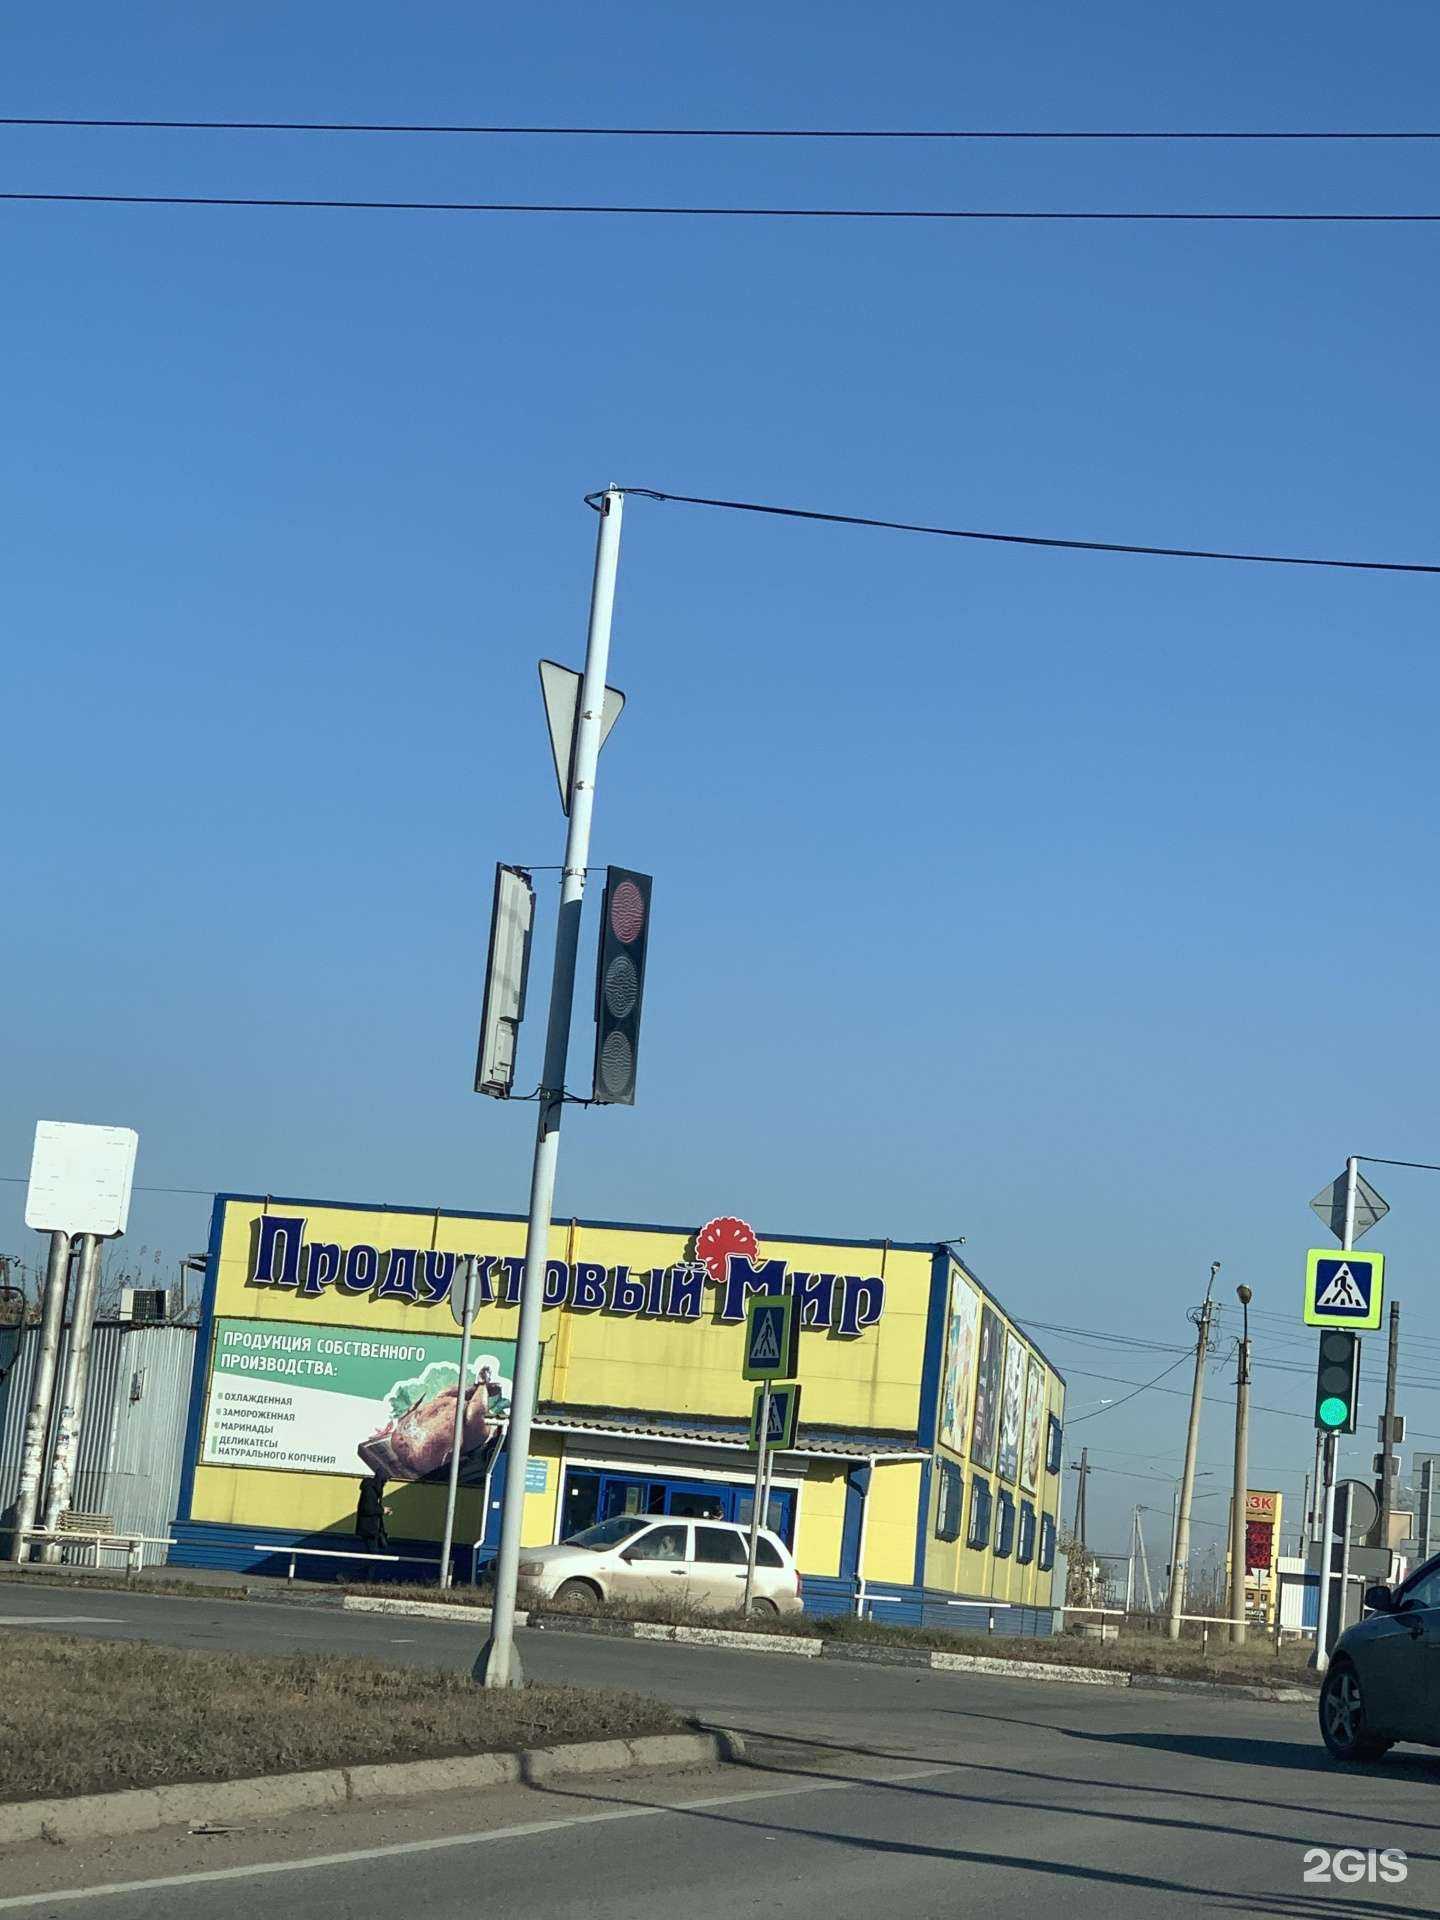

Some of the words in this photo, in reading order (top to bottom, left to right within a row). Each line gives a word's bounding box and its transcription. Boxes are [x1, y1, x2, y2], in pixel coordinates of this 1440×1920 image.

[223, 1331, 312, 1353] ПРОДУКЦИЯ
[316, 1338, 426, 1362] СОБСТВЕННОГО
[220, 1353, 338, 1377] ПРОИЗВОДСТВА:
[223, 1391, 293, 1406] ОХЛАЖДЕННАЯ
[222, 1407, 296, 1422] ЗАМОРОЖЕННАЯ
[220, 1421, 274, 1434] МАРИНАДЫ
[218, 1436, 279, 1449] ДЕЛИКАТЕСЫ
[217, 1446, 287, 1461] НАТУРАЛЬНОГО
[287, 1452, 336, 1465] КОПЧЕНИЯ
[1245, 1495, 1273, 1510] ЗК
